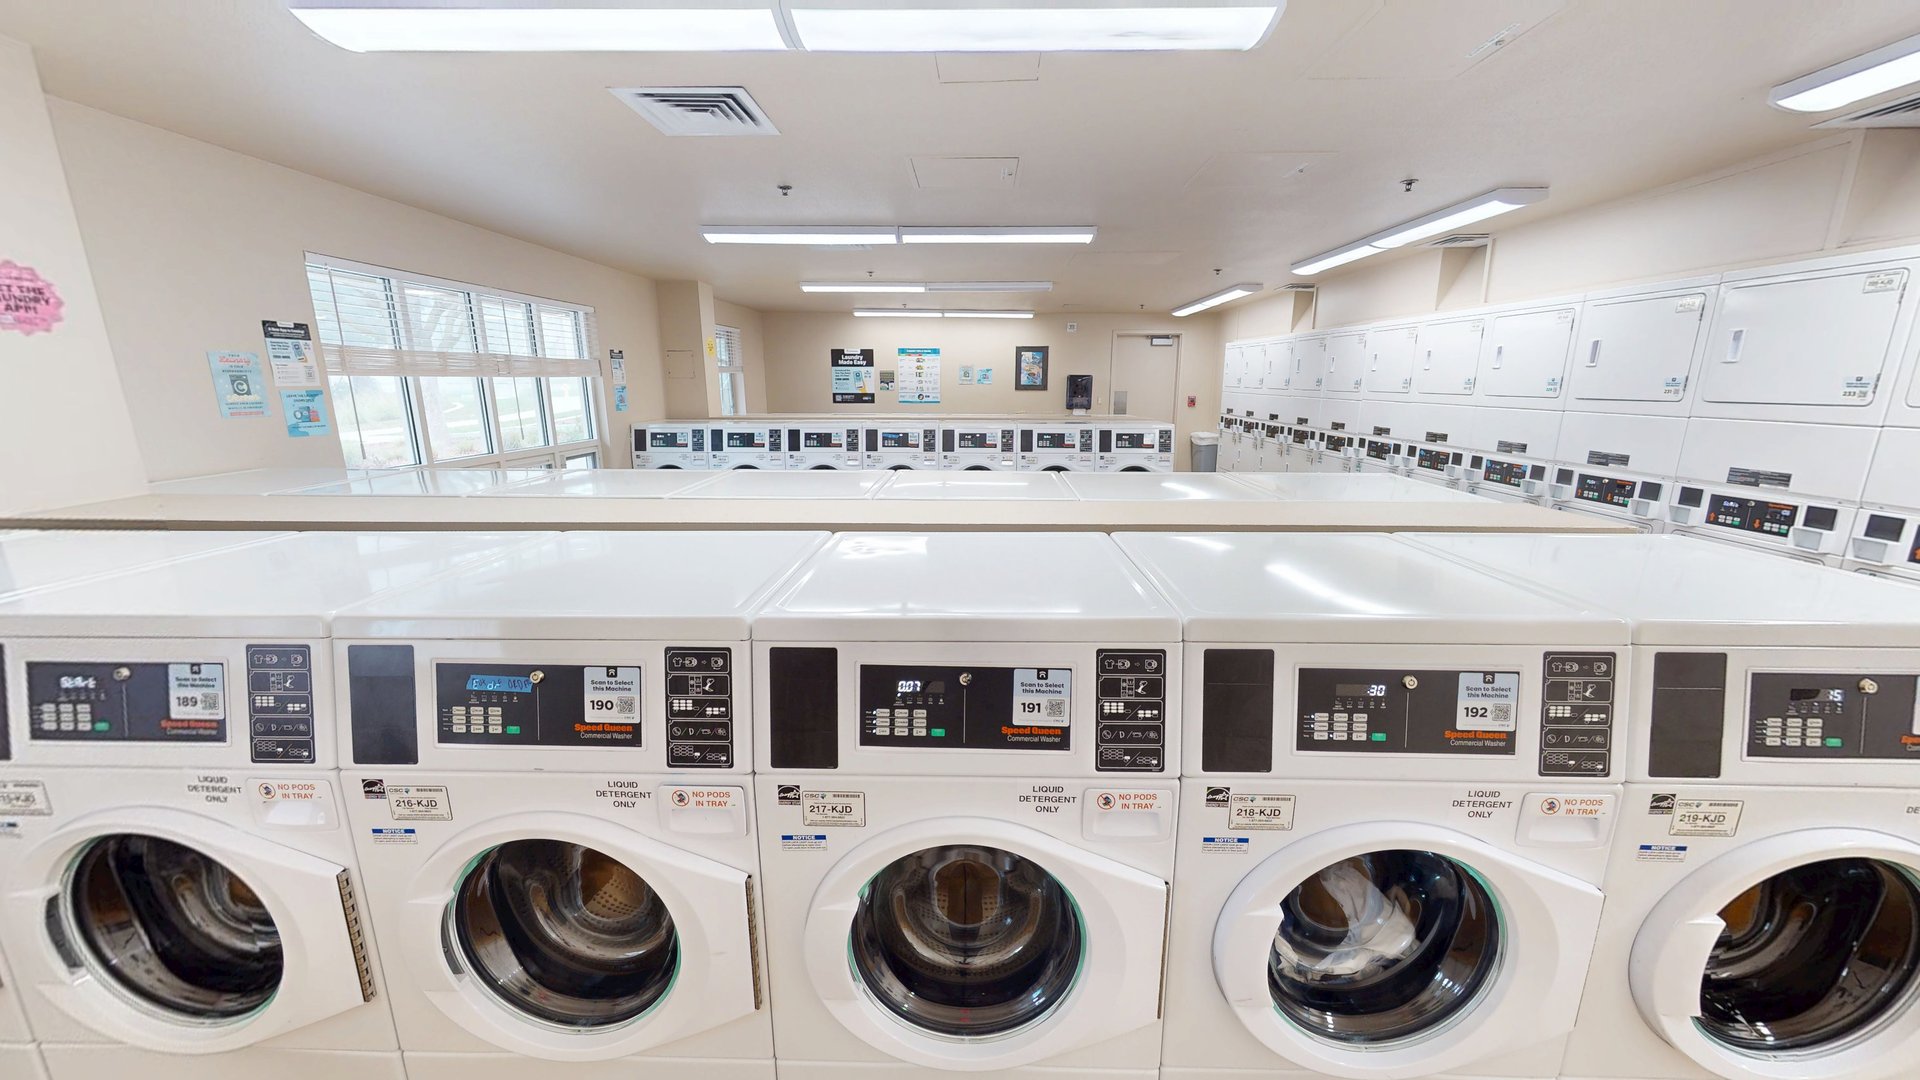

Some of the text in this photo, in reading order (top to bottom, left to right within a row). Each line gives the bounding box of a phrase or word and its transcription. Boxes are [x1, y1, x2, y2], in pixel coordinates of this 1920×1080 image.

[16, 285, 45, 295] THE
[176, 696, 198, 707] 189
[590, 700, 614, 710] 190
[1021, 702, 1041, 713] 191
[1464, 707, 1488, 718] 192
[575, 723, 632, 732] Speed Queen
[1001, 726, 1061, 735] Speed Queen
[1444, 730, 1507, 739] Speed Queen
[198, 775, 228, 784] LIQUID
[187, 784, 242, 794] DETERGENT
[596, 790, 652, 799] DETERGENT
[1467, 790, 1501, 798] LIQUID
[205, 795, 228, 803] ONLY
[395, 799, 438, 808] 216-KJD
[1019, 795, 1077, 803] DETERGENT
[613, 800, 636, 808] ONLY
[1452, 800, 1512, 808] DETERGENT
[810, 805, 852, 813] 217-KJD
[1236, 808, 1281, 816] 218-KJD
[1679, 814, 1726, 822] 219-KJD
